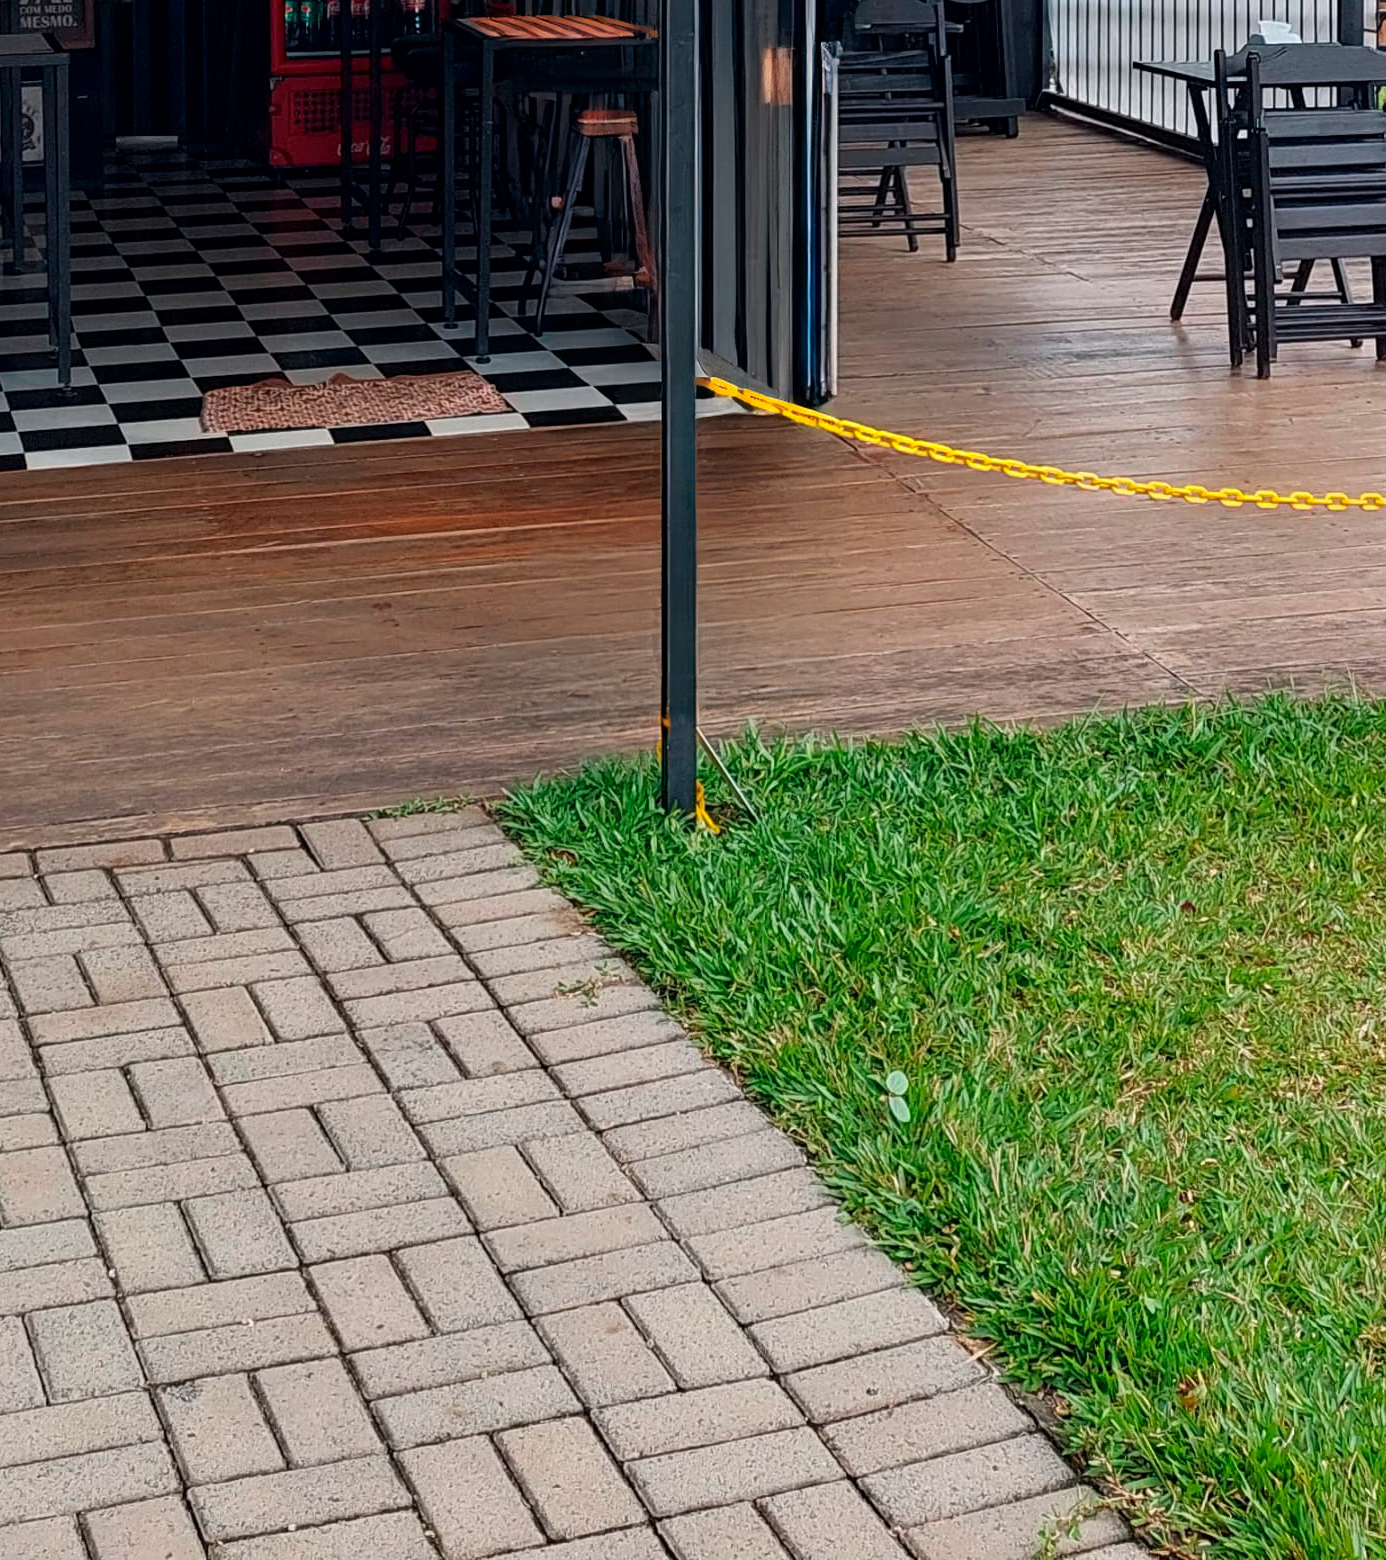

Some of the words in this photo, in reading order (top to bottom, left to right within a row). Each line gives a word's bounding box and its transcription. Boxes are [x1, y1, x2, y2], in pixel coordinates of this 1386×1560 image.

[20, 5, 41, 15] COM
[44, 4, 73, 15] MEDO
[20, 15, 78, 29] MESMO.
